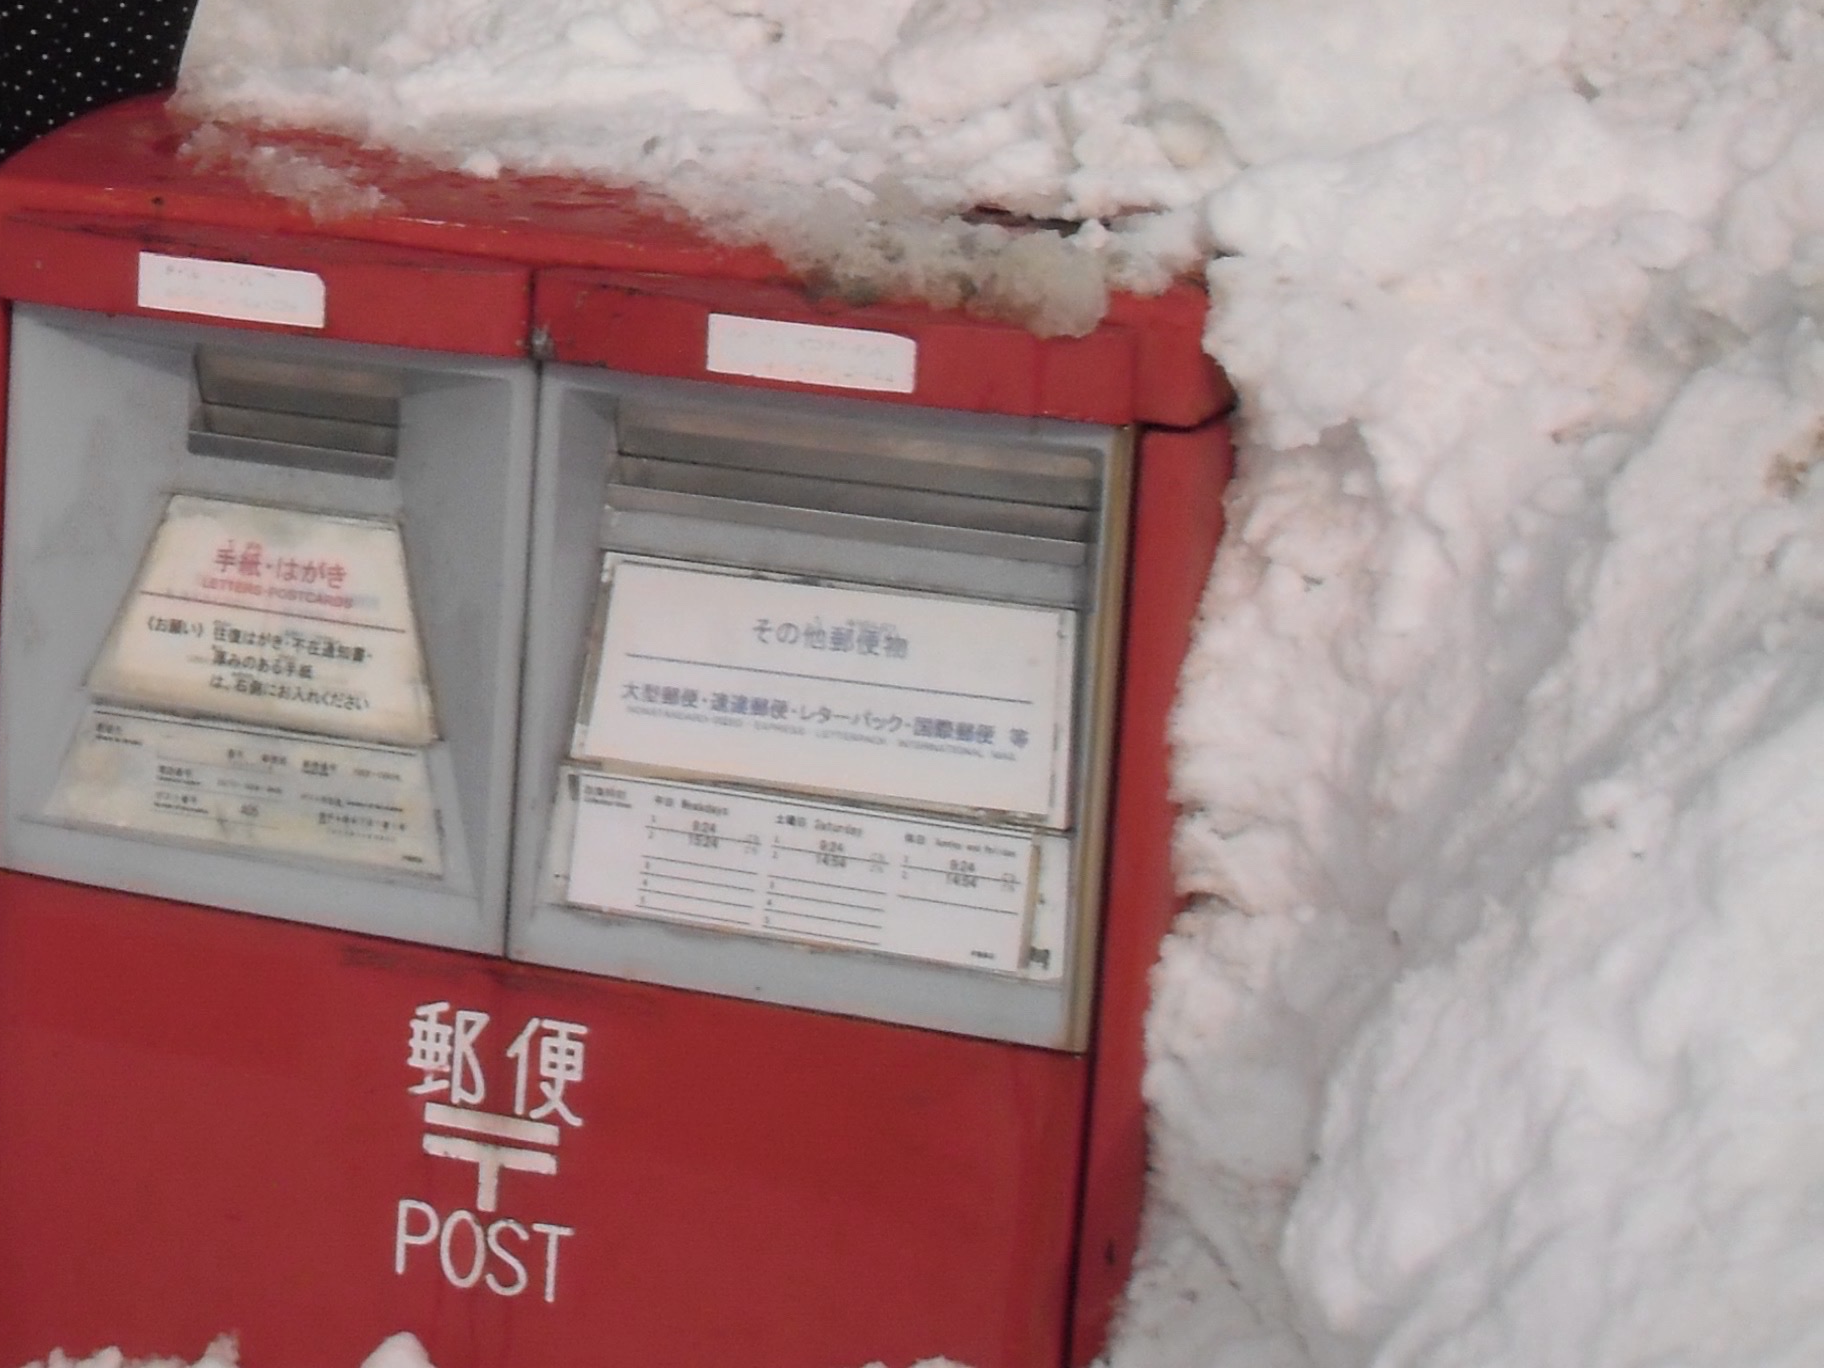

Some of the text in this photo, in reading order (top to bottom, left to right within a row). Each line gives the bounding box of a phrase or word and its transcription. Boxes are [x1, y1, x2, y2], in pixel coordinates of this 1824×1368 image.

[214, 548, 348, 589] 手紙・はがき
[752, 618, 909, 659] その他郵便物
[407, 1001, 588, 1127] 郵便
[394, 1198, 574, 1303] POST
